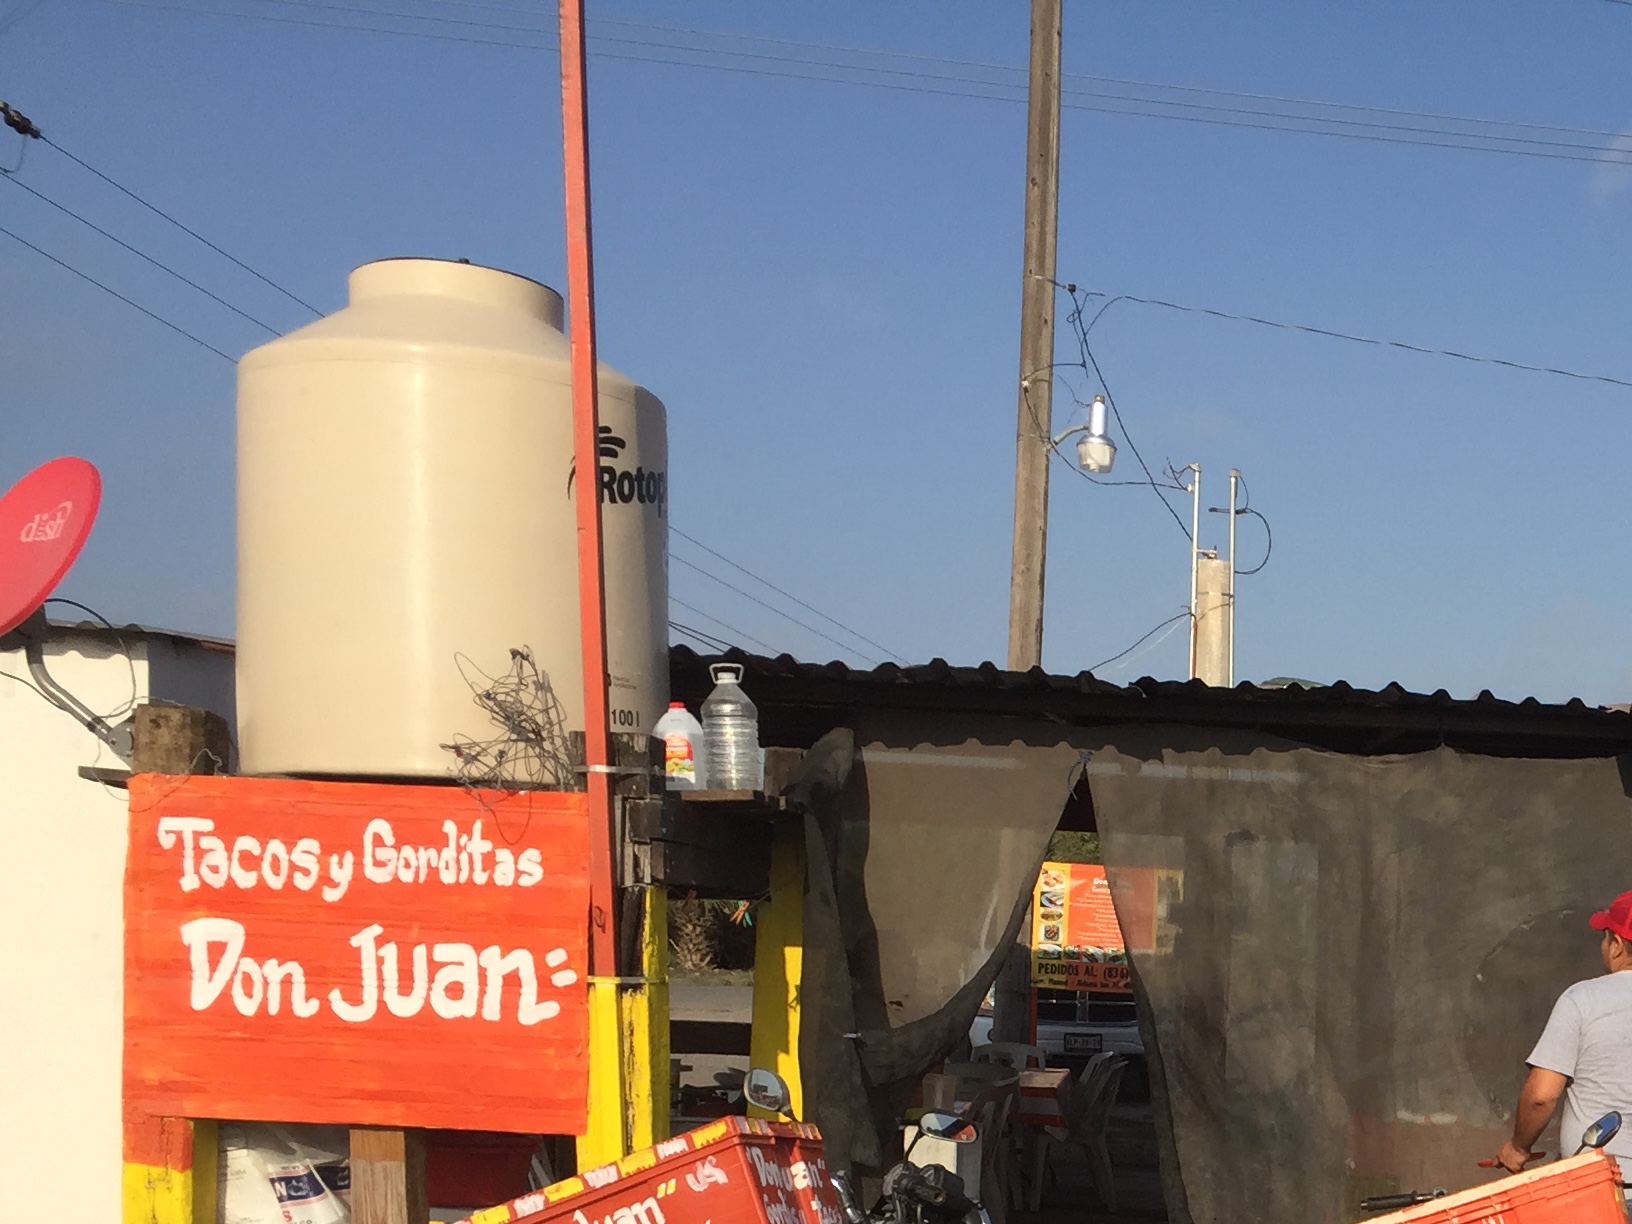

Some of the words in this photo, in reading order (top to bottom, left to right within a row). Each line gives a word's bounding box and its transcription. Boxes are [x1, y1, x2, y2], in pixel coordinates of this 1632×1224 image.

[157, 816, 320, 892] Tacos
[321, 849, 355, 902] y
[362, 818, 543, 887] Gorditas
[180, 917, 320, 1017] Don
[1037, 962, 1079, 977] PEDIDOS
